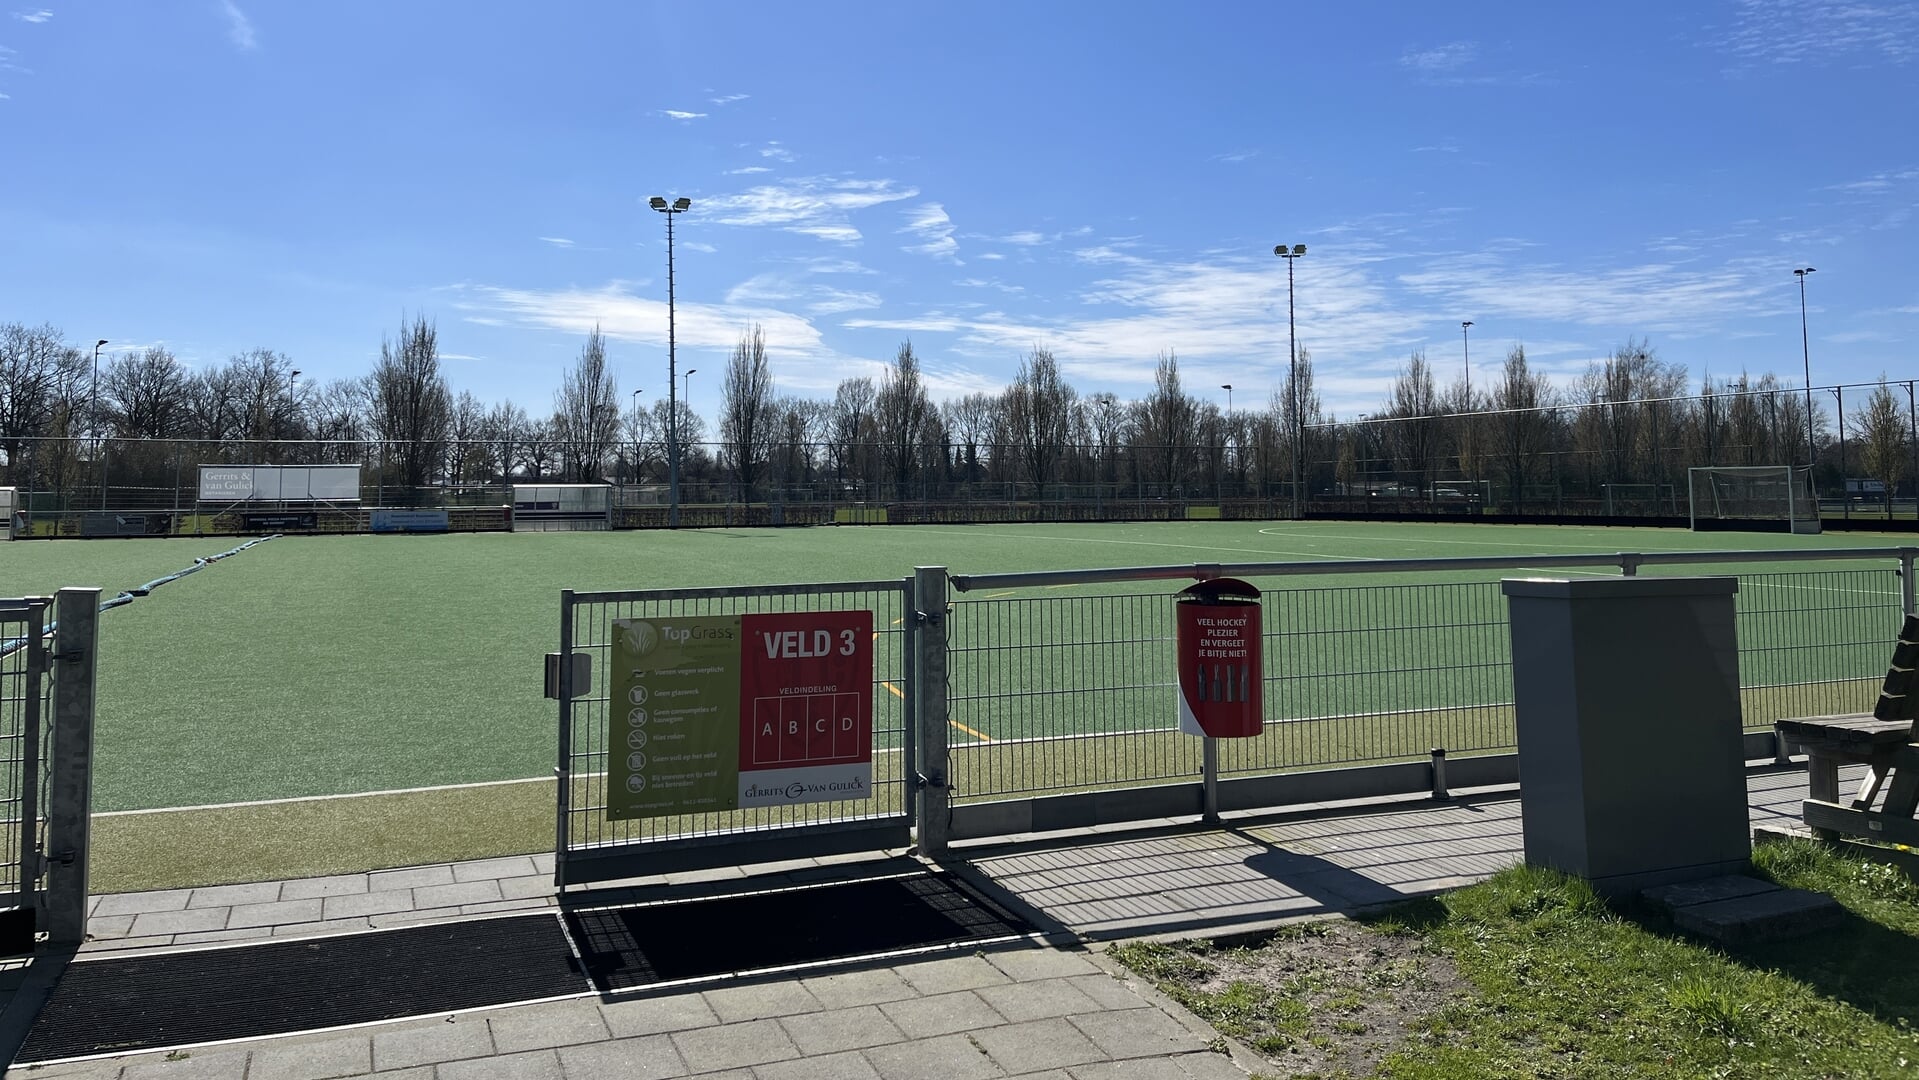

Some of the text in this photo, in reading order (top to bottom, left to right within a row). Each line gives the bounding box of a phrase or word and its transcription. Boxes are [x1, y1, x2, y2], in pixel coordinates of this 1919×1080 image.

[205, 471, 250, 481] Gerrits &
[224, 481, 253, 490] Gulick
[1197, 618, 1247, 626] VEEL HOCKEY
[662, 625, 733, 645] TopGrass
[1207, 629, 1238, 637] PLEZIER
[763, 629, 855, 659] VELD 3
[1200, 639, 1245, 647] EN VERGEET
[1198, 649, 1247, 659] JE BITJE NIET!
[779, 685, 837, 695] VELDINDELING
[762, 717, 853, 736] A B C D
[745, 781, 864, 798] GERRITS VAN GULICK
